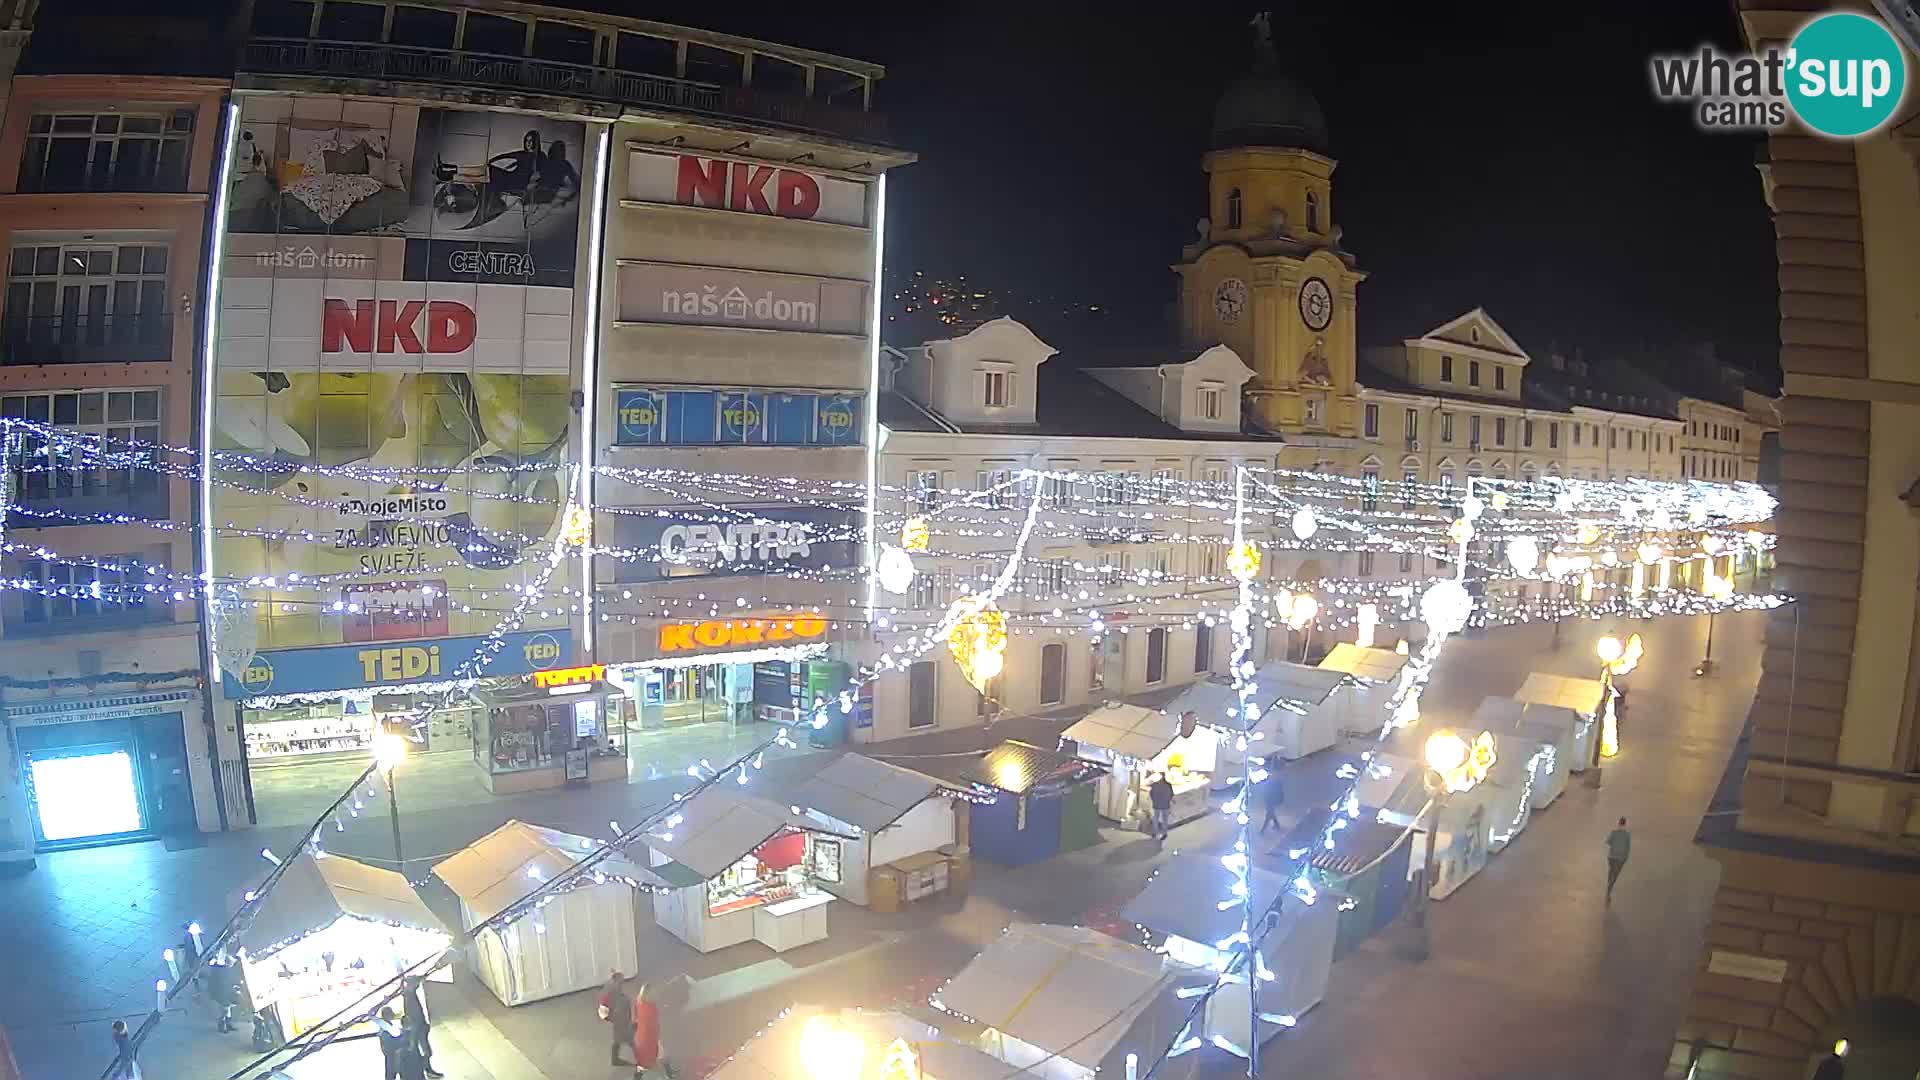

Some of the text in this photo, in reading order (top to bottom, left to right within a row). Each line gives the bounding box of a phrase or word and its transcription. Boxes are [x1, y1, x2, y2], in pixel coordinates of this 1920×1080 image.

[676, 155, 821, 219] NKD
[255, 244, 368, 271] naš dom
[448, 250, 536, 276] CENTRA
[662, 284, 817, 324] naš dom
[321, 298, 479, 354] NKD
[619, 408, 657, 426] TEDi
[723, 409, 760, 426] TEDi
[820, 410, 853, 426] TEDi
[339, 498, 447, 516] #TvojeMisto
[335, 524, 450, 549] ZA DNEVNO
[659, 522, 811, 564] CENTRA
[358, 645, 441, 682] TEDi
[523, 643, 561, 662] TEDi
